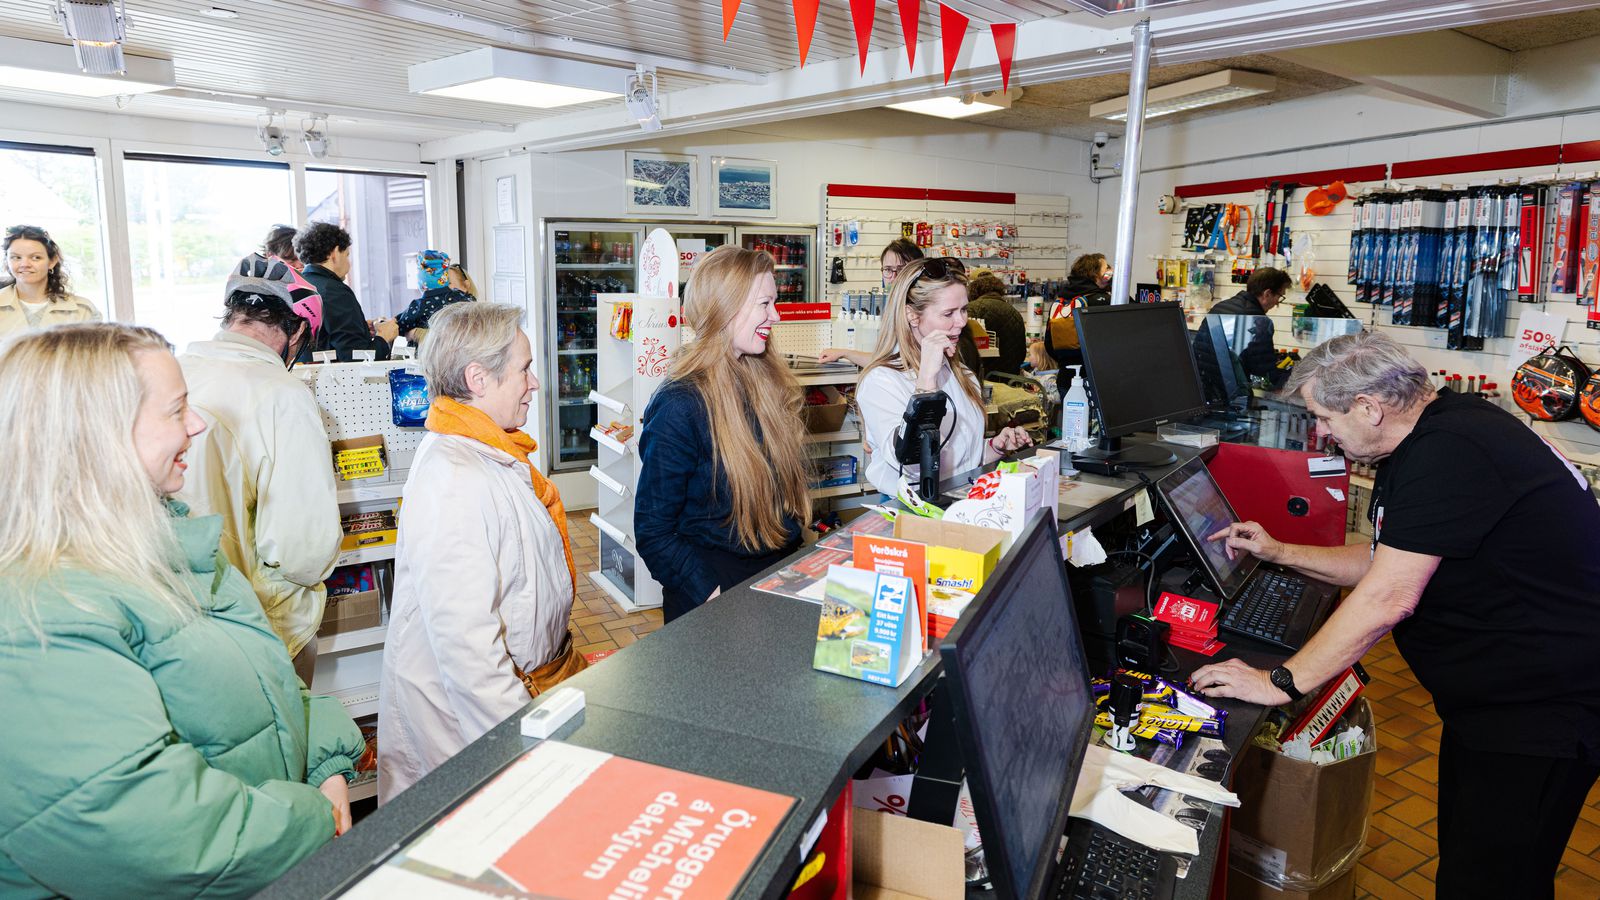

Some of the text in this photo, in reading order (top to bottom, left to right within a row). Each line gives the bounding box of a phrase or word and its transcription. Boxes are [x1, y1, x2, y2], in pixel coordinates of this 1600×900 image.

[936, 577, 973, 589] Smash!
[689, 799, 715, 813] á
[583, 791, 680, 880] dekkjum
[655, 808, 757, 900] Öruggar
